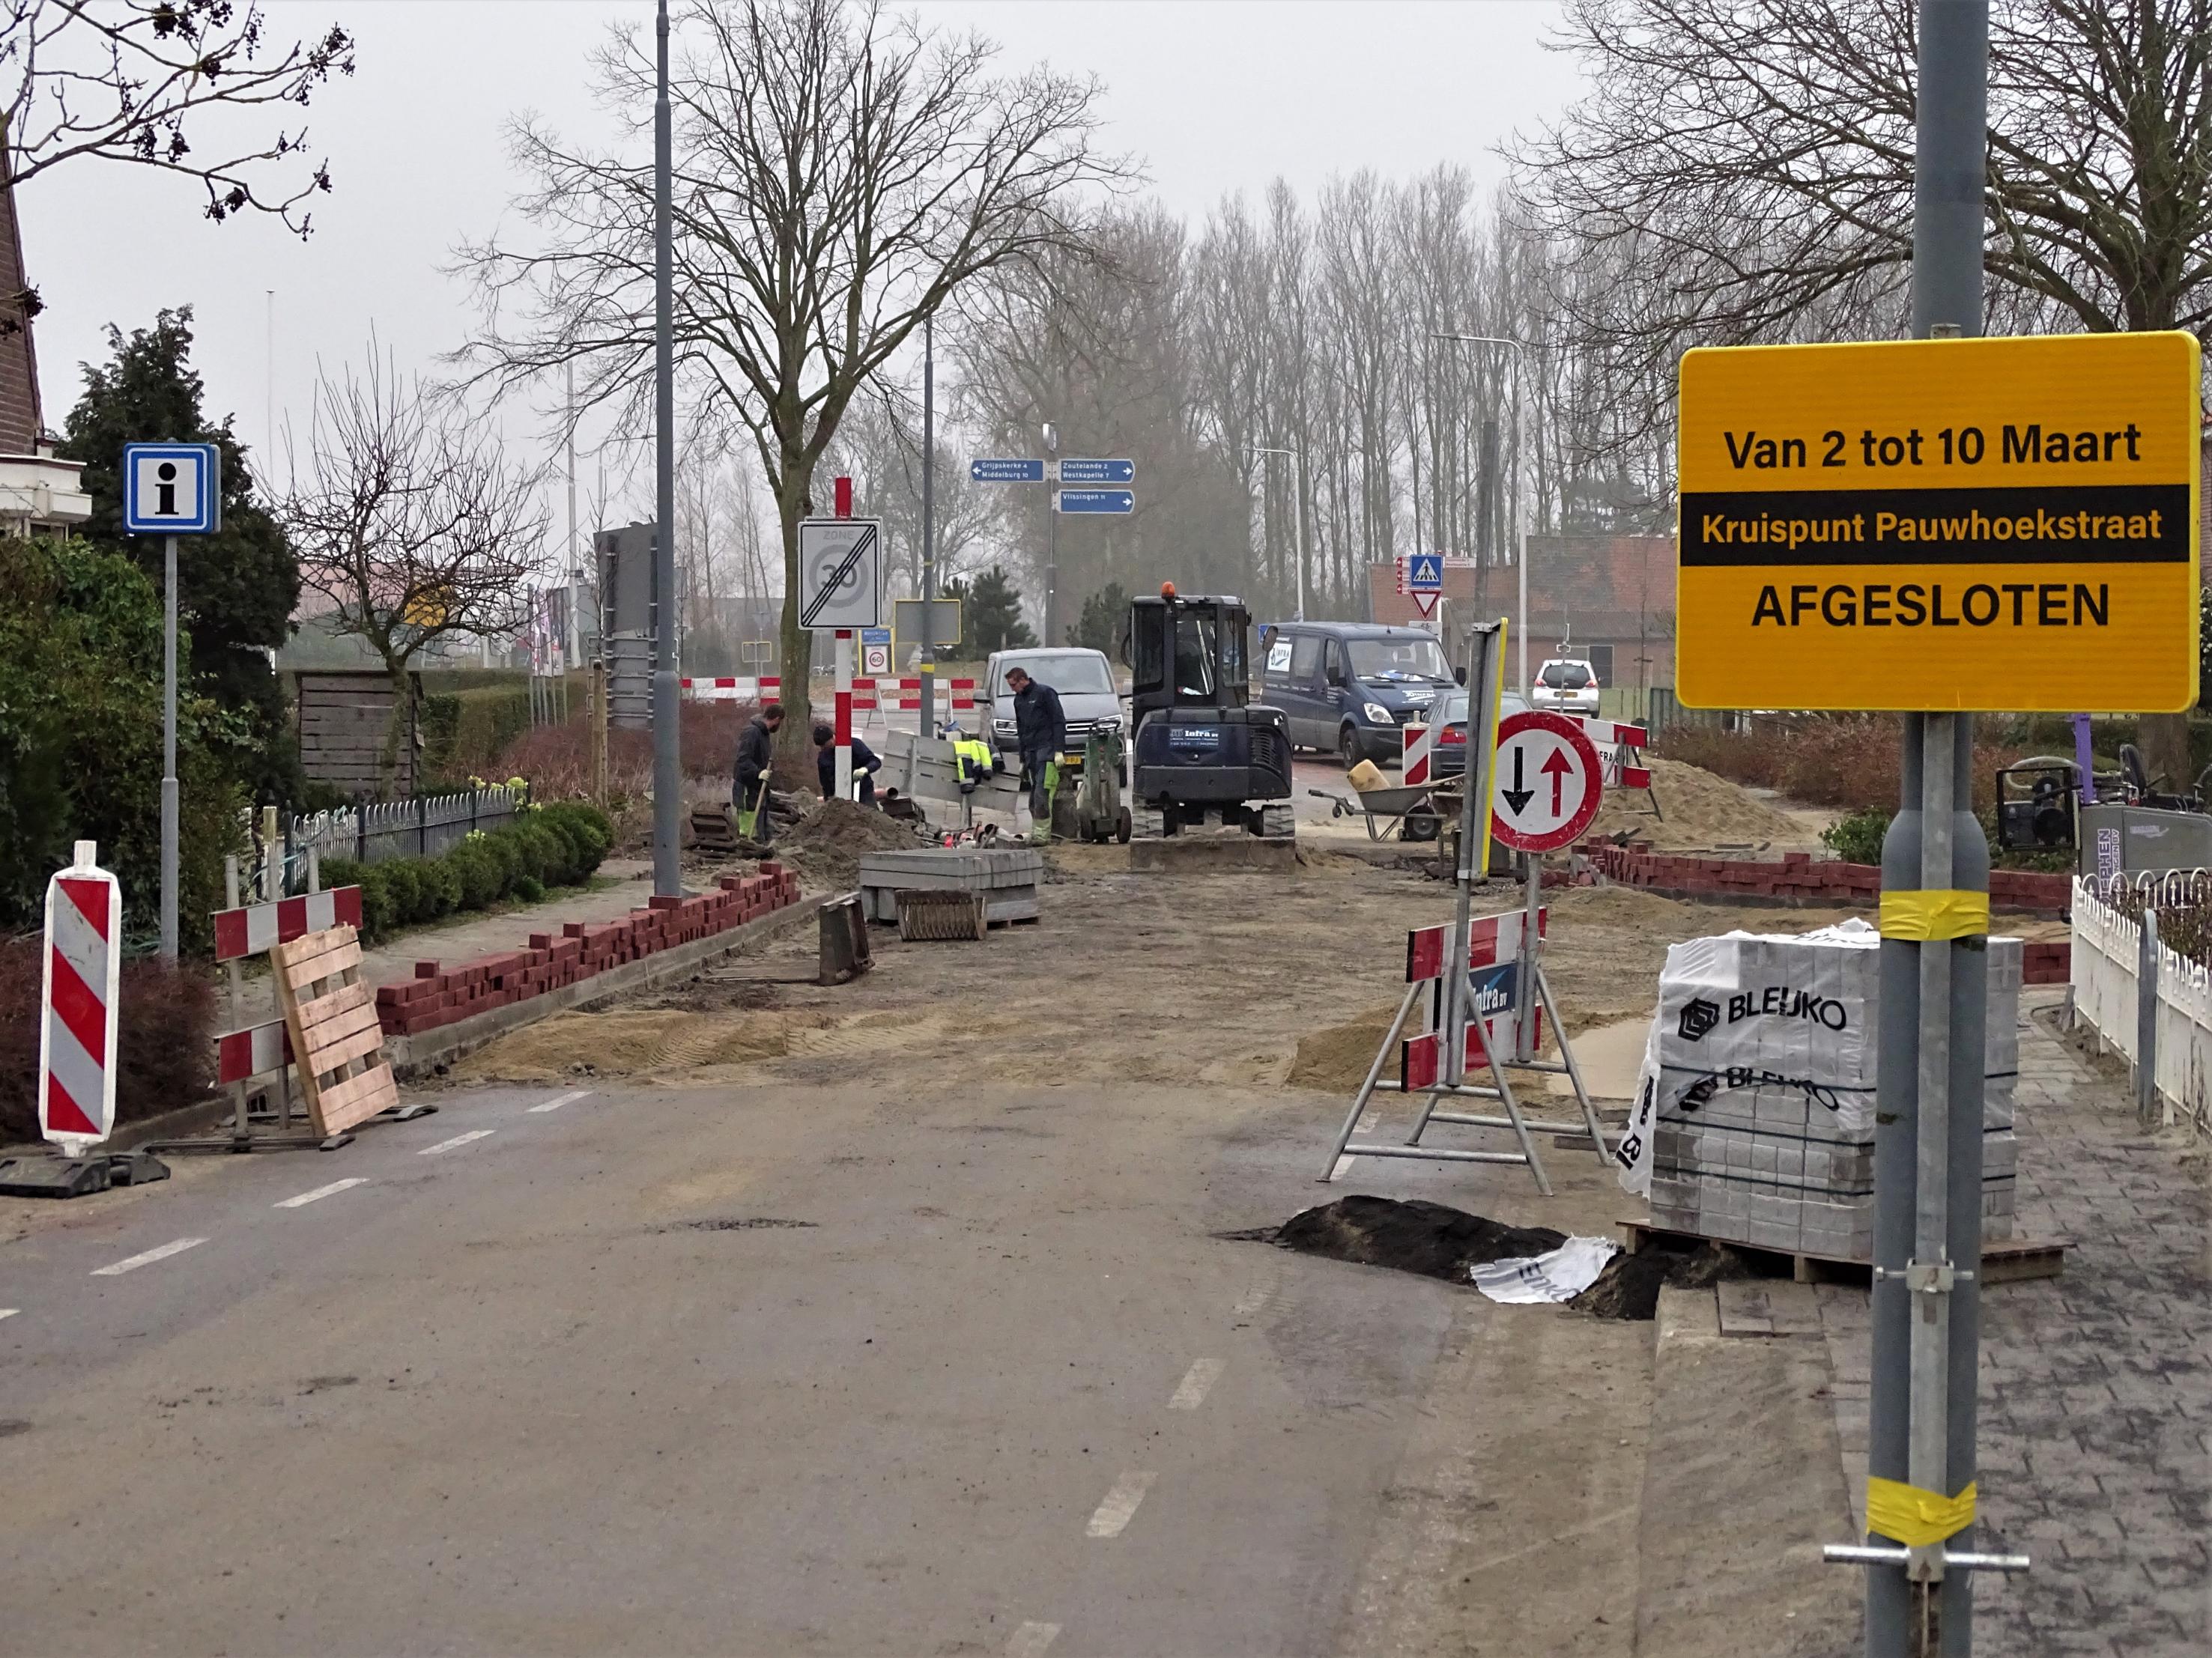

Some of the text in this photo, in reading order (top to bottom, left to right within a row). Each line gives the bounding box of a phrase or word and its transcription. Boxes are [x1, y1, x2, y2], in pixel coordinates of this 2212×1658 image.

[1724, 424, 2142, 470] Van 2 tot 10 Maart
[981, 462, 1022, 470] Grijpskerke
[1062, 493, 1100, 501] Vlissingen
[823, 530, 855, 540] ZONE
[1701, 508, 2163, 550] Kruispunt Pauwhoekstraat
[821, 564, 858, 589] 30
[1751, 583, 2109, 628] AFGESLOTEN
[1599, 750, 1613, 762] FRA
[1727, 986, 1847, 1031] BLEIJKO
